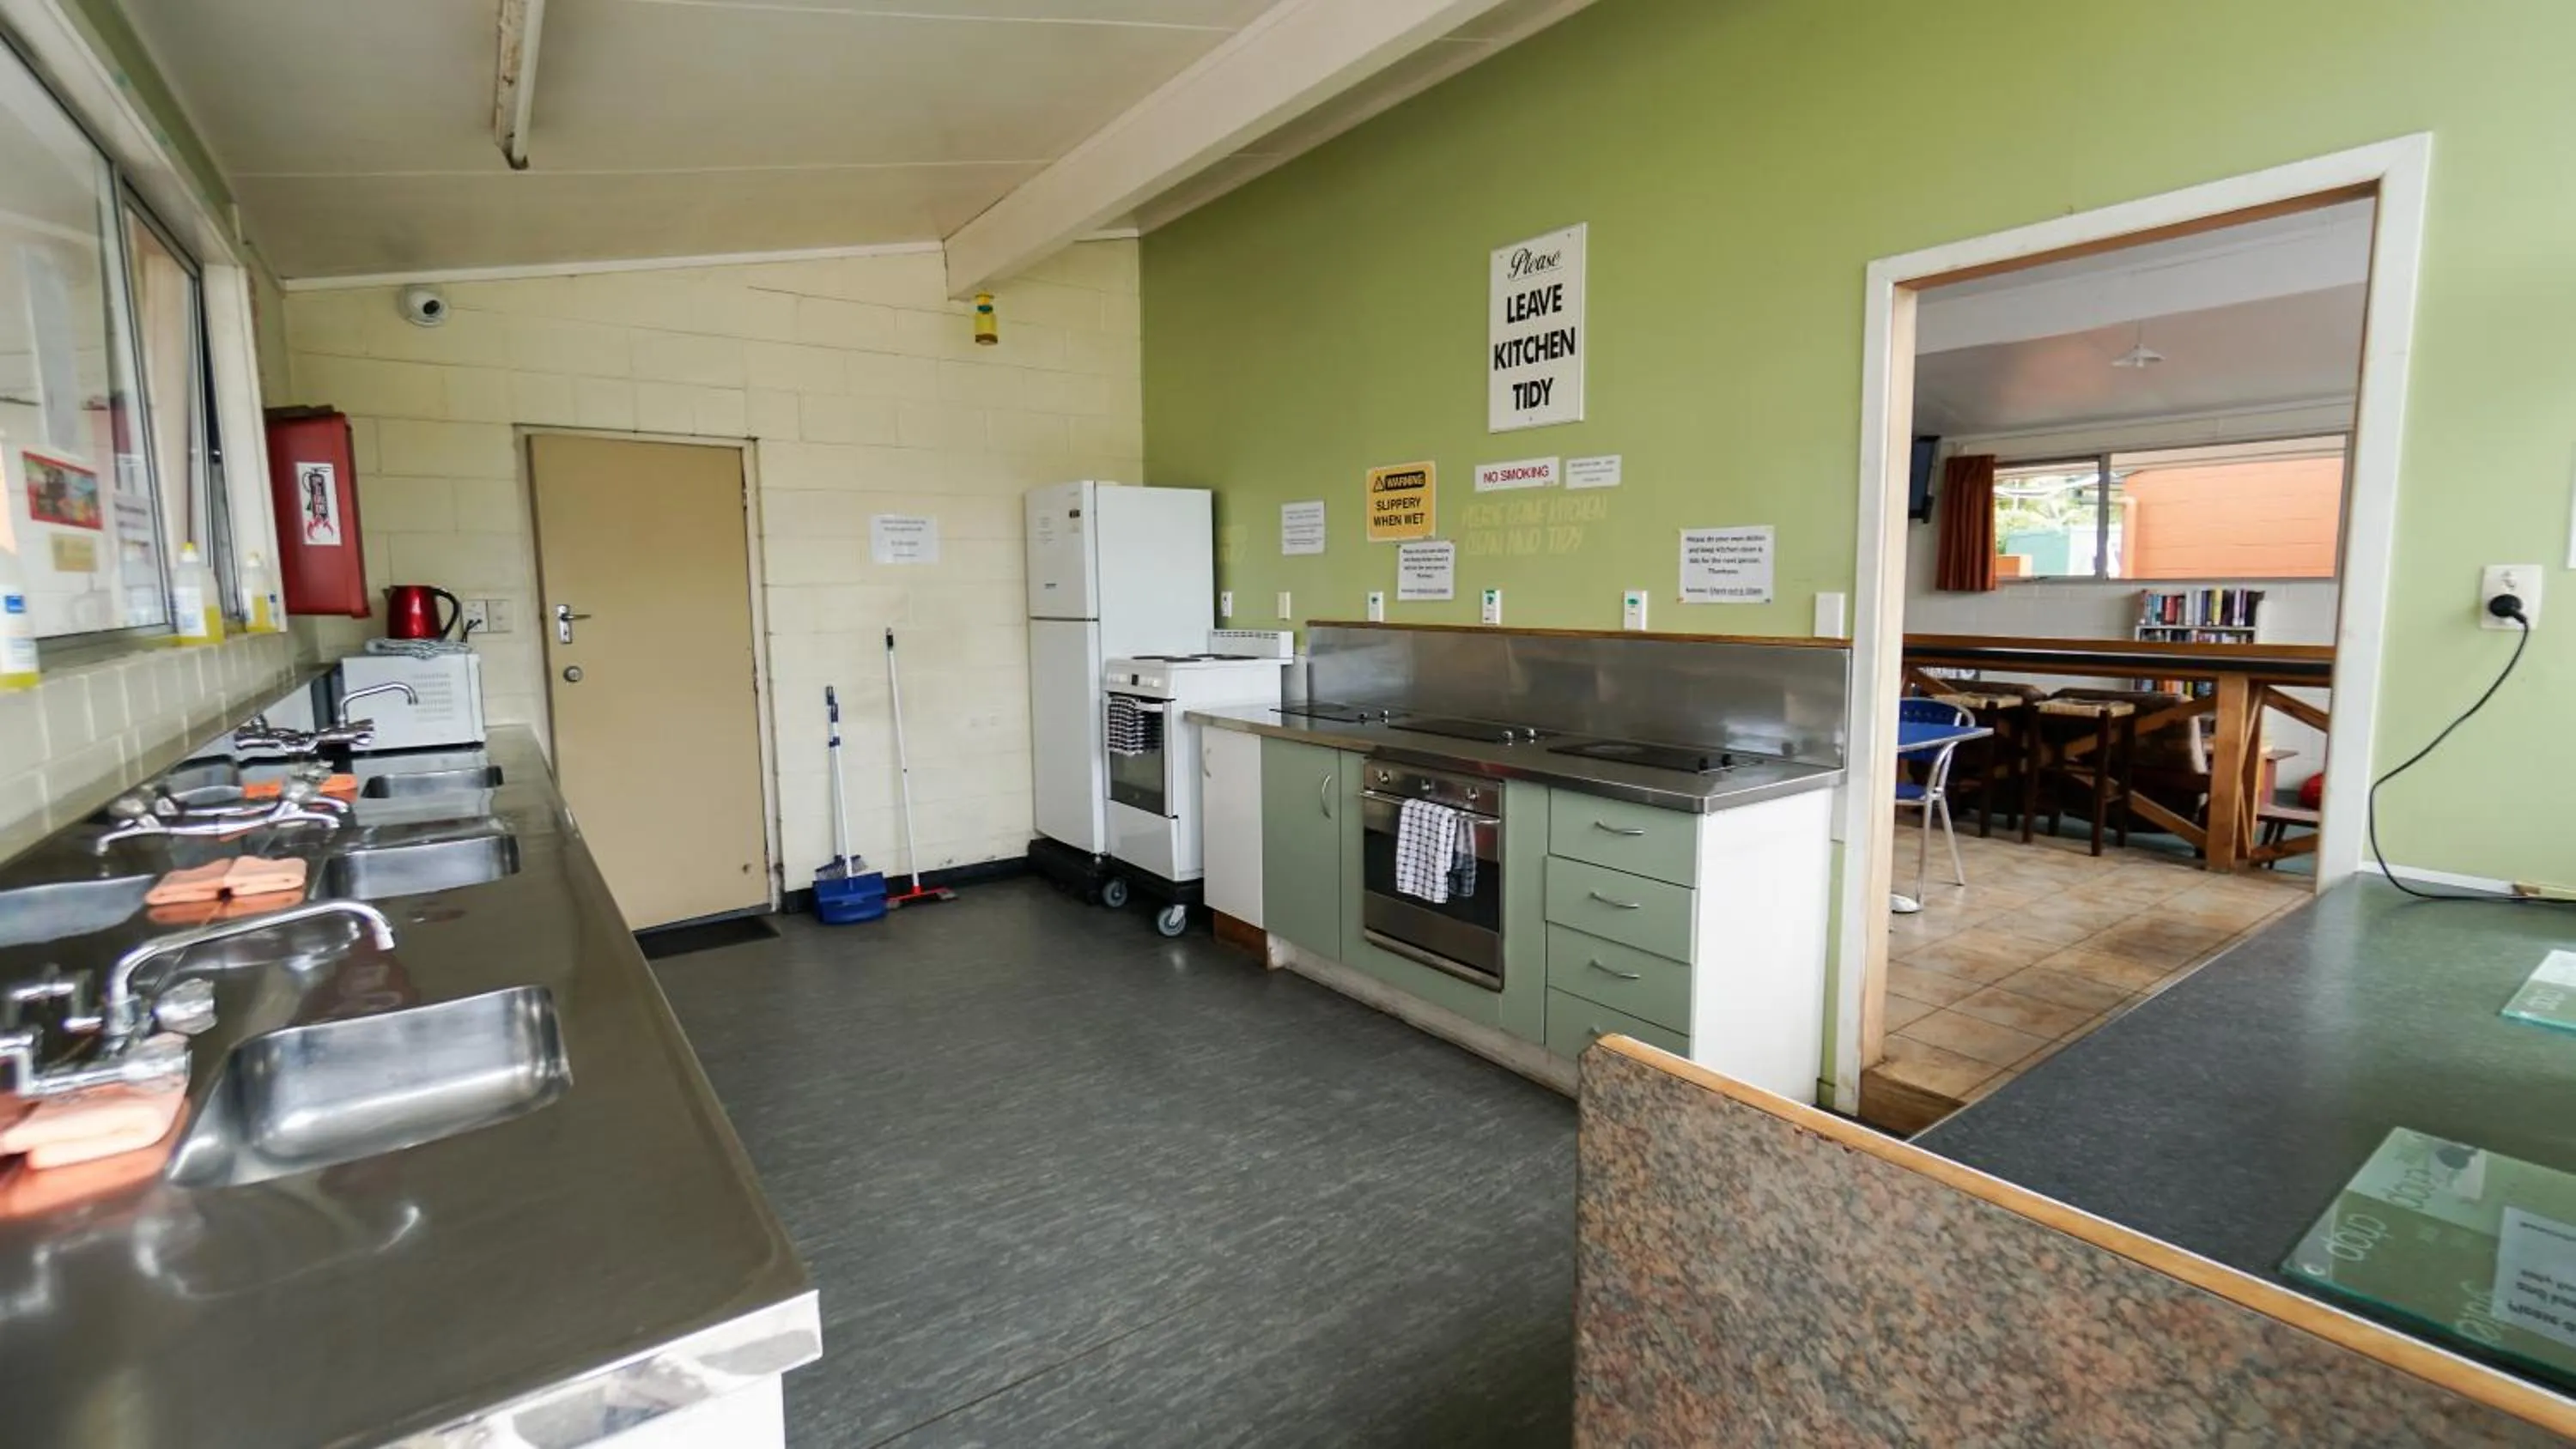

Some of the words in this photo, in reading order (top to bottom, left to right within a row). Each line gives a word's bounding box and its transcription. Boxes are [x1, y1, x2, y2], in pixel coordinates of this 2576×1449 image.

[1507, 247, 1562, 280] Please
[1506, 282, 1564, 324] LEAVE
[1493, 327, 1576, 371] KITCHEN
[1512, 377, 1555, 410] TIDY
[1386, 474, 1424, 488] WARNING
[1483, 471, 1498, 484] NO
[1500, 464, 1550, 482] SMOKING
[1376, 497, 1421, 512] SLIPPERY
[1373, 514, 1402, 527] WHEN
[1404, 512, 1425, 525] WET
